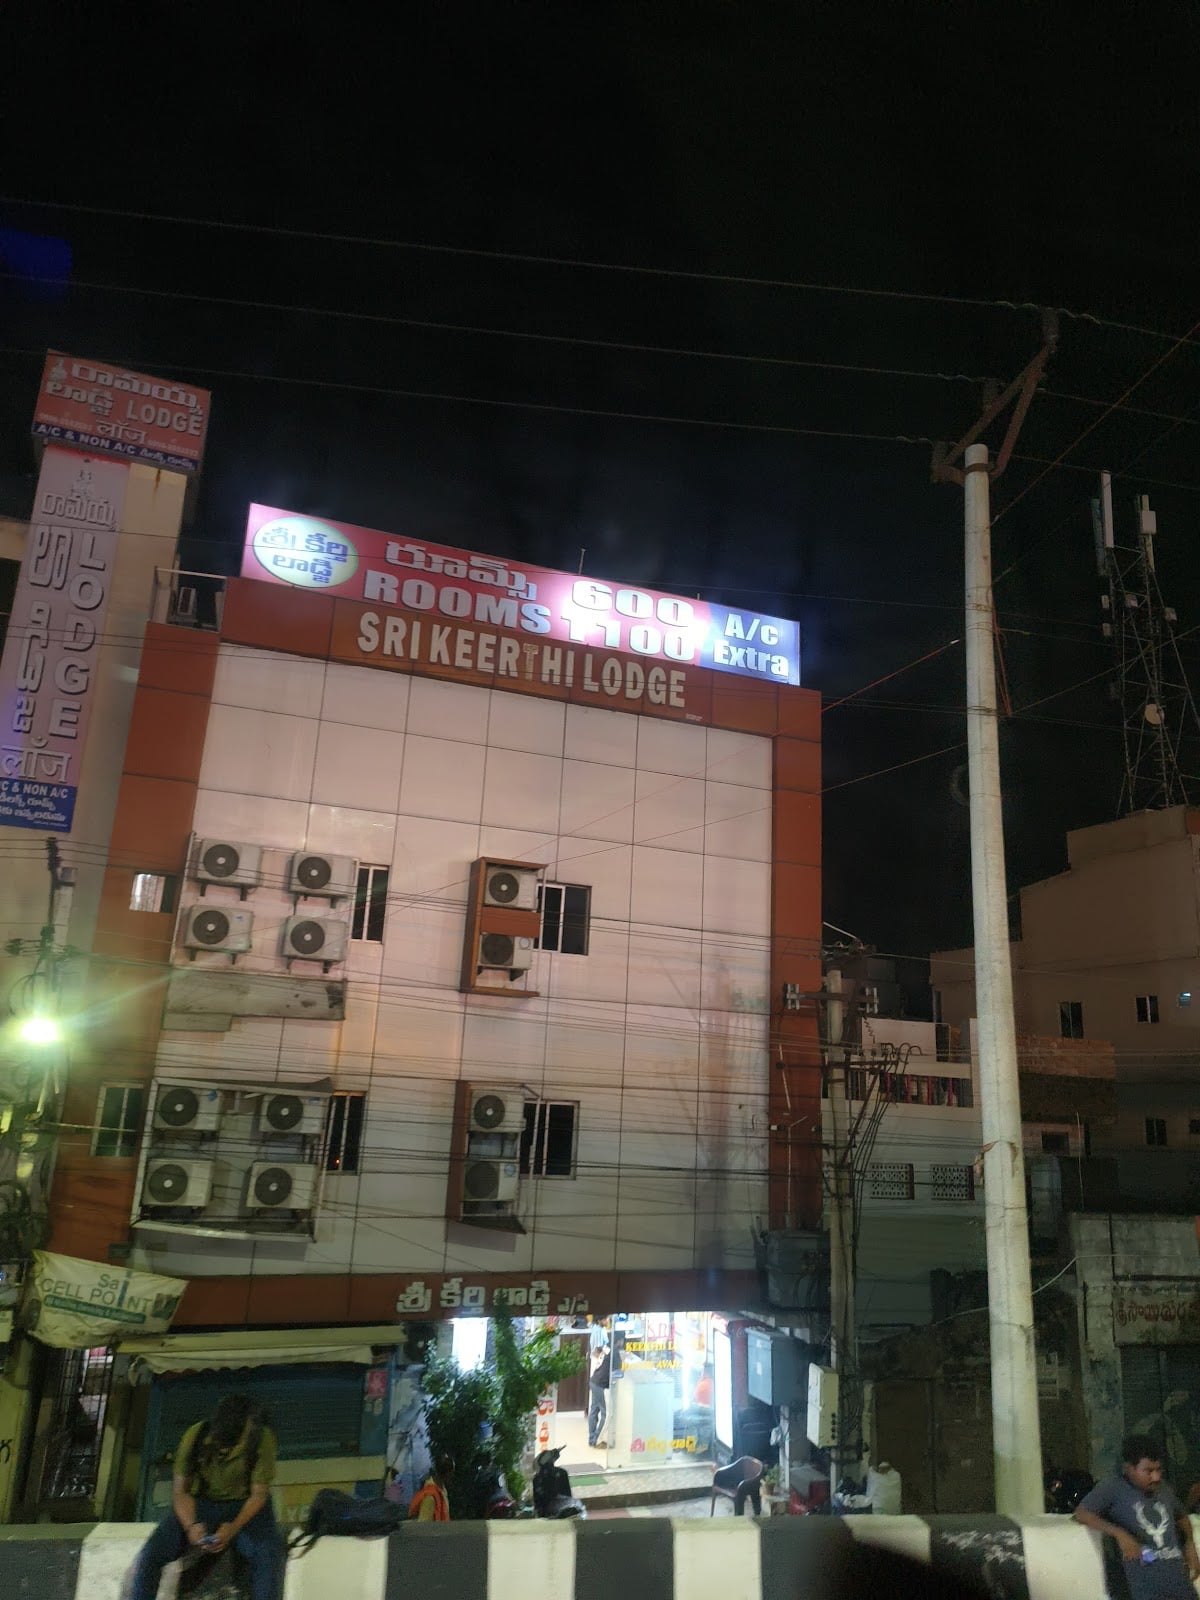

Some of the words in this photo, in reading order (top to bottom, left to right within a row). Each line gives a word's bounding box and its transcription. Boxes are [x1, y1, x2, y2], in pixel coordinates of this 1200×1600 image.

[95, 415, 147, 445] लॉज
[126, 399, 203, 437] LODGE
[37, 424, 60, 438] A/C
[65, 429, 75, 440] &
[80, 432, 110, 449] NON
[113, 440, 136, 454] A/C
[363, 569, 551, 635] ROOMS
[572, 580, 695, 628] 600
[49, 532, 106, 738] LODGE
[357, 611, 420, 660] SRI
[429, 623, 575, 688] KEERTHI
[584, 653, 687, 708] LODGE
[713, 639, 789, 677] Extra
[0, 735, 72, 784] लॉज
[23, 783, 48, 796] NON
[42, 1278, 83, 1300] CELL
[396, 1281, 432, 1314] శ్రీ
